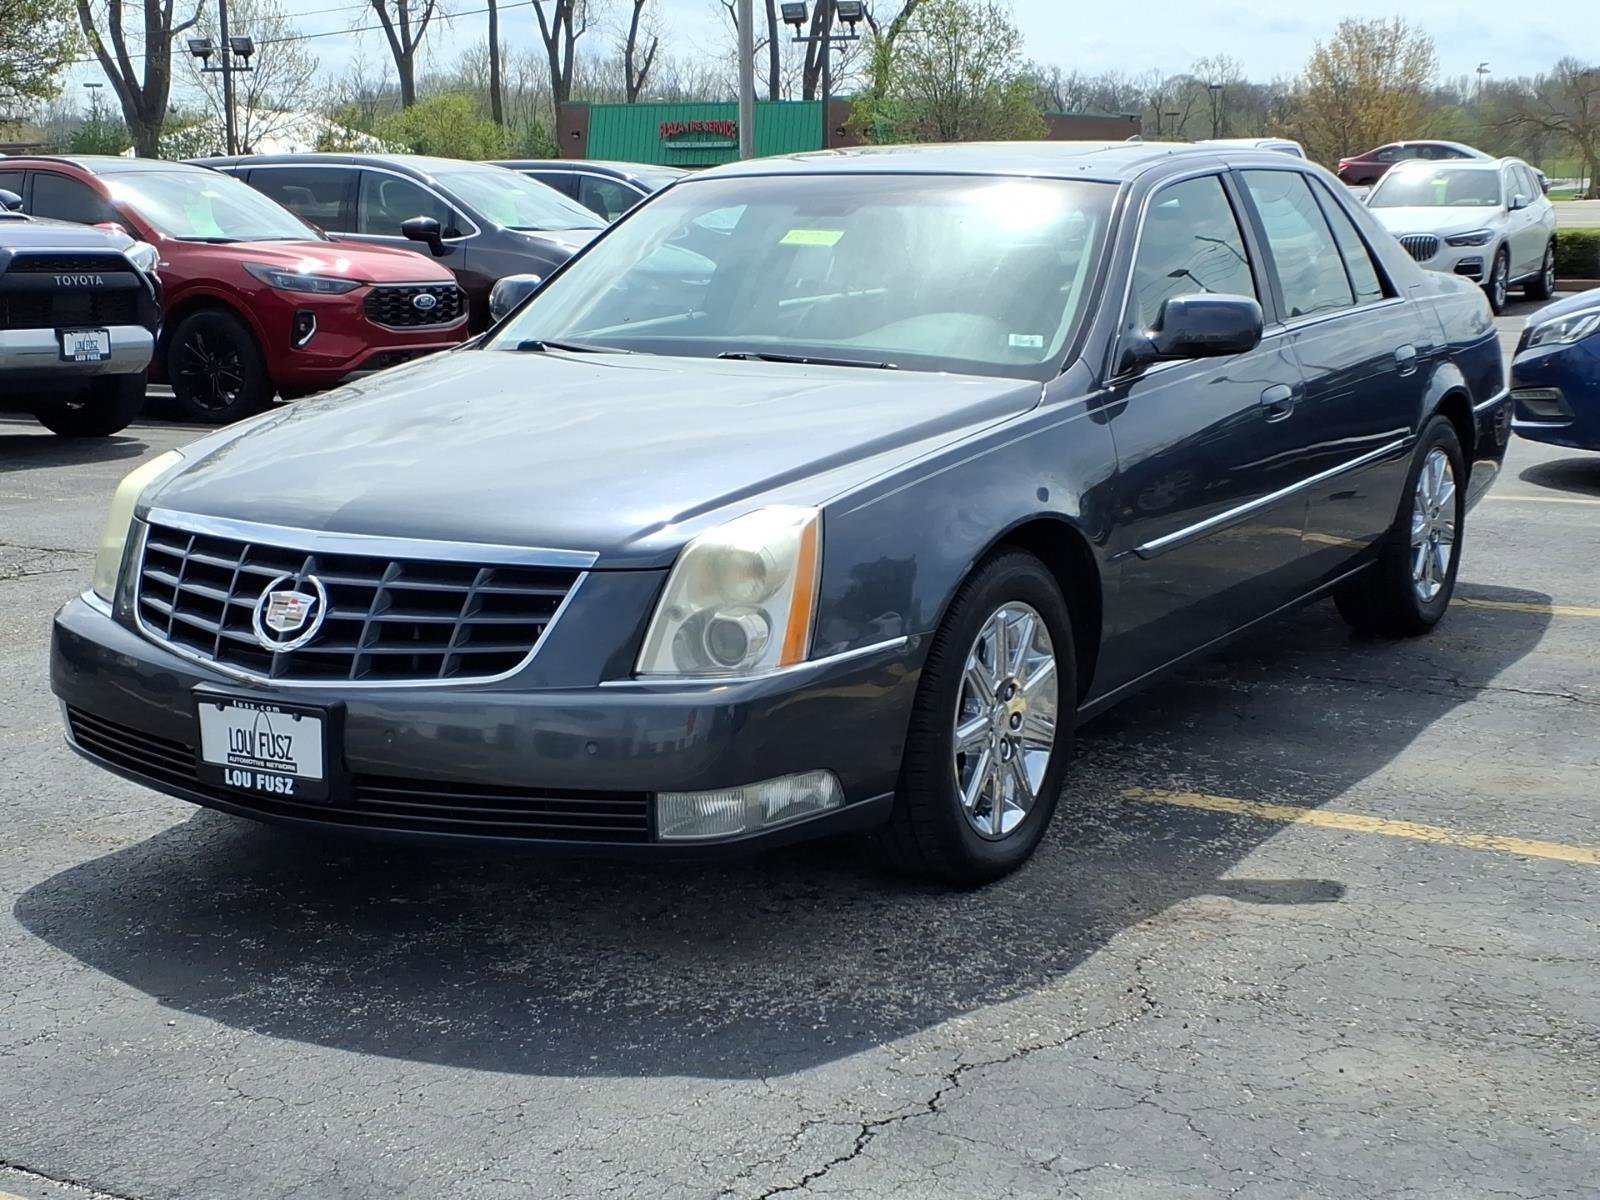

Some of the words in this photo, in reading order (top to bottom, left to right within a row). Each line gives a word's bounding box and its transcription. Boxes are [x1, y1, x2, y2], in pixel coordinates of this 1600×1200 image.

[659, 121, 684, 139] PLAZA
[703, 119, 737, 139] SERVICE
[54, 275, 104, 286] TOYOTA
[233, 700, 280, 713] fusz.com
[229, 727, 252, 756] LOU
[259, 731, 294, 761] FUSZ
[229, 755, 265, 767] AUTOMOTIVE
[266, 759, 296, 771] NETWORK
[225, 768, 252, 788] LOU
[256, 773, 294, 795] FUSZ
